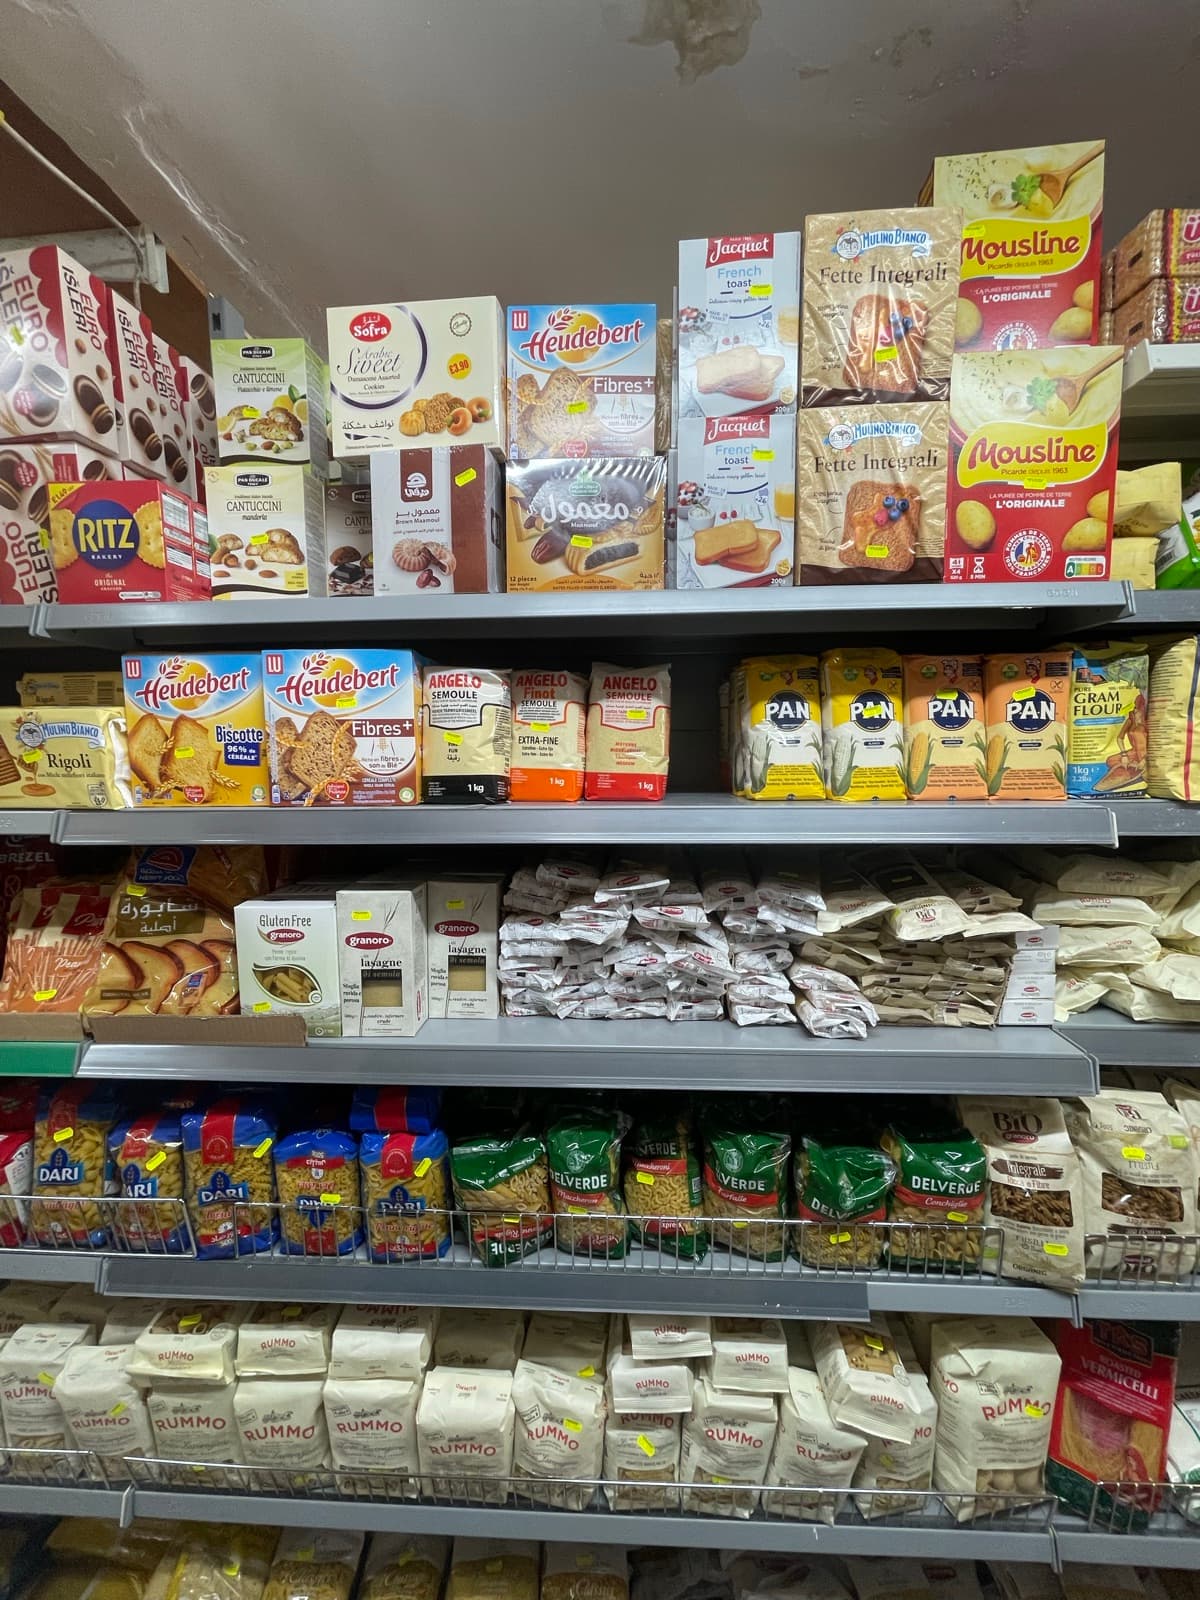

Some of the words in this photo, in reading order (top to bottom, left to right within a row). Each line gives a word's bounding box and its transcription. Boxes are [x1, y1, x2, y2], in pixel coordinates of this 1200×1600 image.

[863, 230, 893, 248] MULINO
[893, 229, 927, 244] BIANCO
[710, 238, 769, 263] Jacquet
[960, 229, 1081, 266] Mousline
[717, 266, 761, 279] French
[820, 266, 863, 284] Fette
[870, 262, 948, 288] Integrali
[727, 279, 752, 288] toast
[982, 289, 1052, 304] L'ORIGINALE
[14, 275, 48, 352] EURO
[513, 312, 527, 329] LU
[80, 292, 102, 350] EURO
[353, 324, 387, 338] Sofra
[520, 319, 645, 362] Heudebert
[131, 328, 150, 384] EURO
[337, 347, 400, 375] Sweet
[232, 373, 285, 384] CANTUCCINI
[161, 361, 179, 412] EURO
[708, 418, 765, 440] Jacquet
[855, 422, 885, 438] MULINO
[716, 445, 758, 455] French
[968, 437, 1097, 470] Mousline
[725, 456, 748, 465] toast
[815, 456, 857, 474] Fette
[863, 449, 939, 472] Integrali
[1001, 468, 1027, 476] Picarde
[226, 501, 282, 512] CANTUCCINI
[996, 500, 1065, 509] L'ORIGINALE
[77, 518, 135, 553] RITZ
[5, 521, 38, 593] EURO
[267, 656, 282, 673] LU
[276, 664, 400, 706] Heudebert
[429, 674, 482, 688] ANGELO
[516, 674, 568, 687] ANGELO
[603, 677, 657, 691] ANGELO
[135, 668, 250, 709] Heudebert
[432, 690, 478, 699] SEMOULE
[606, 692, 652, 700] SEMOULE
[1074, 692, 1119, 704] GRAM
[1073, 704, 1122, 716] FLOUR
[42, 724, 70, 738] MULINO
[71, 722, 99, 737] BIANCO
[216, 725, 263, 743] Biscotte
[518, 736, 559, 745] EXTRA-FINE
[47, 753, 92, 772] Rigoli
[473, 784, 485, 793] kg
[554, 778, 565, 786] kg
[644, 782, 654, 791] kg
[260, 914, 290, 927] Gluten
[291, 914, 312, 927] Free
[270, 931, 302, 940] granoro
[438, 924, 475, 934] granoro
[349, 936, 389, 946] granoro
[448, 944, 486, 955] lasagne
[361, 958, 402, 970] lasagne
[40, 1167, 78, 1182] DARI
[912, 1176, 981, 1195] DELVERDE
[202, 1188, 244, 1202] DARI
[654, 1325, 688, 1336] RUMMO
[261, 1338, 296, 1350] RUMMO
[158, 1351, 194, 1362] RUMMO
[735, 1353, 770, 1364] RUMMO
[1099, 1354, 1141, 1379] ROASTED
[635, 1379, 670, 1390] RUMMO
[1079, 1356, 1159, 1400] VERMICELLI
[870, 1395, 904, 1410] RUMMO
[72, 1417, 130, 1430] RUMMO
[155, 1416, 226, 1431] RUMMO
[337, 1420, 402, 1433] RUMMO
[244, 1425, 315, 1441] RUMMO
[528, 1425, 579, 1451] RUMMO
[705, 1429, 763, 1449] RUMMO
[430, 1443, 496, 1457] RUMMO
